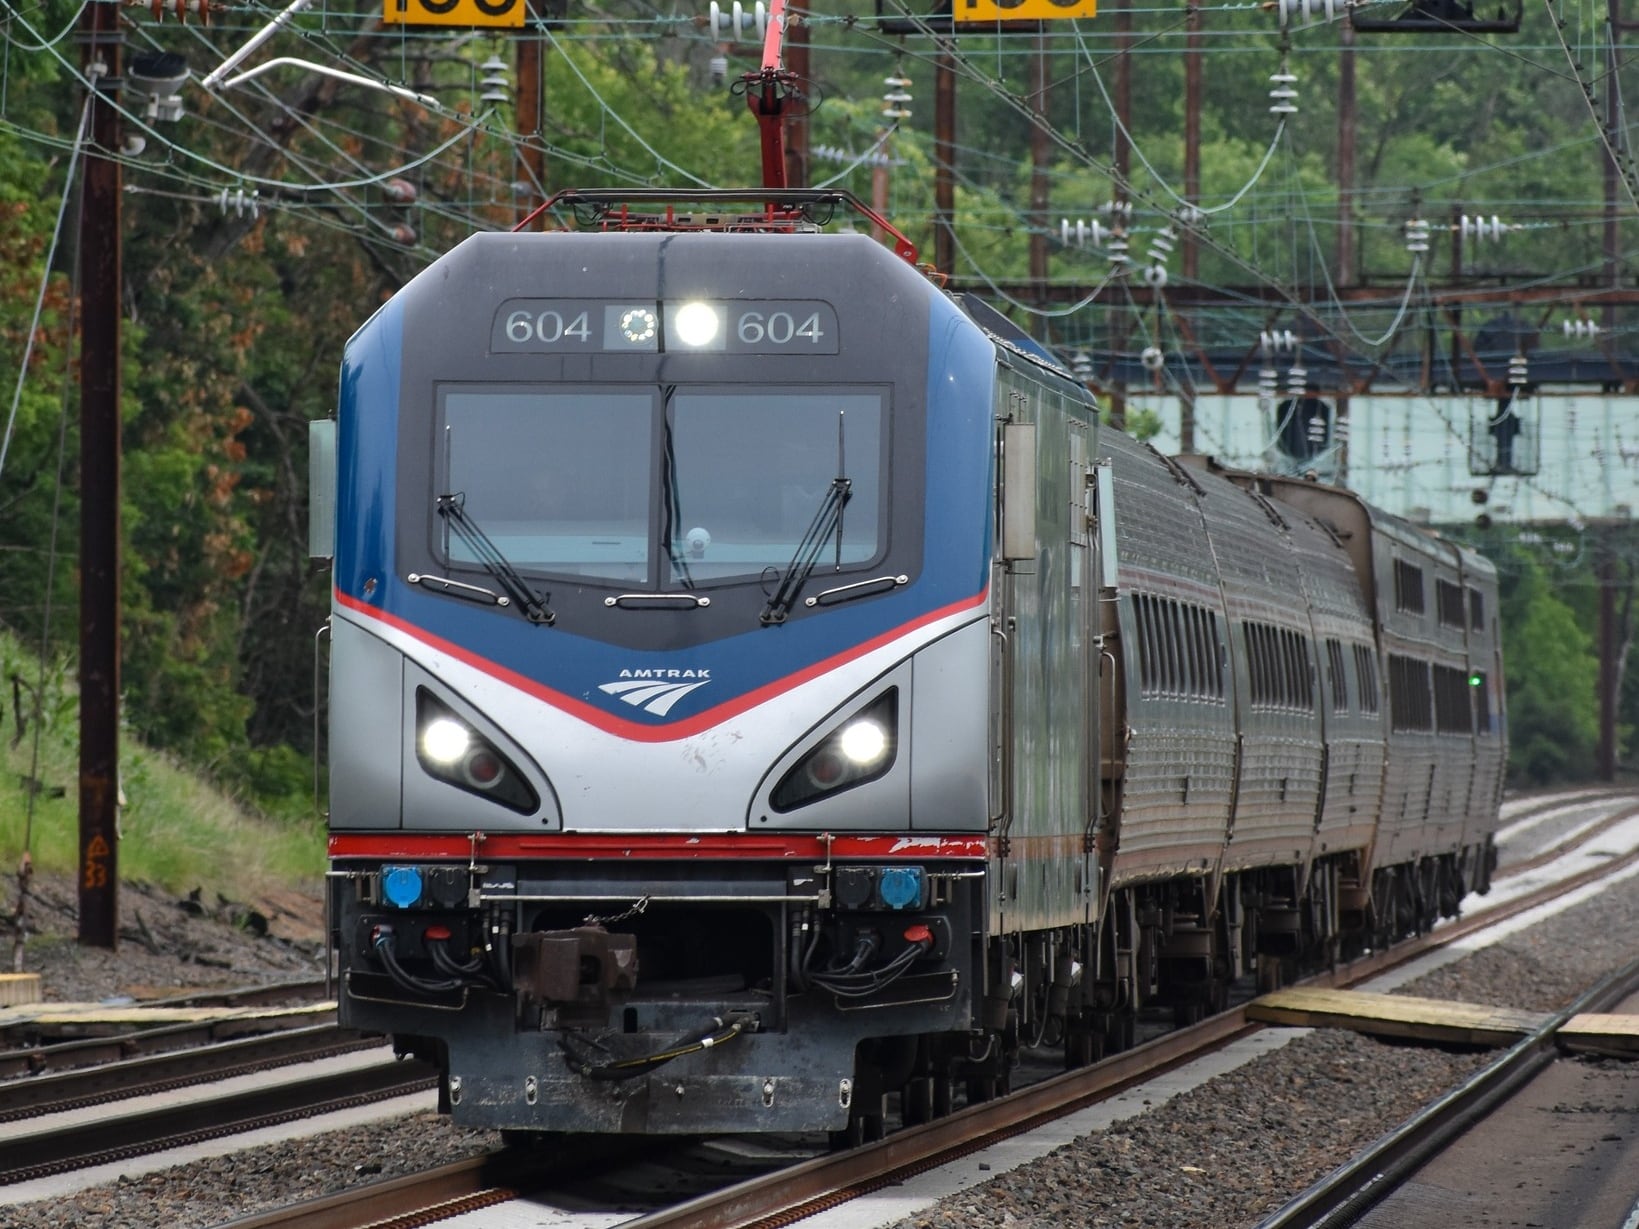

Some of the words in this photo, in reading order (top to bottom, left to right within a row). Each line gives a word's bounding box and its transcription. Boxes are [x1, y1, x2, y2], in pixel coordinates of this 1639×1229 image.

[505, 310, 593, 343] 604
[737, 311, 825, 344] 604
[619, 669, 711, 678] AMTRAK
